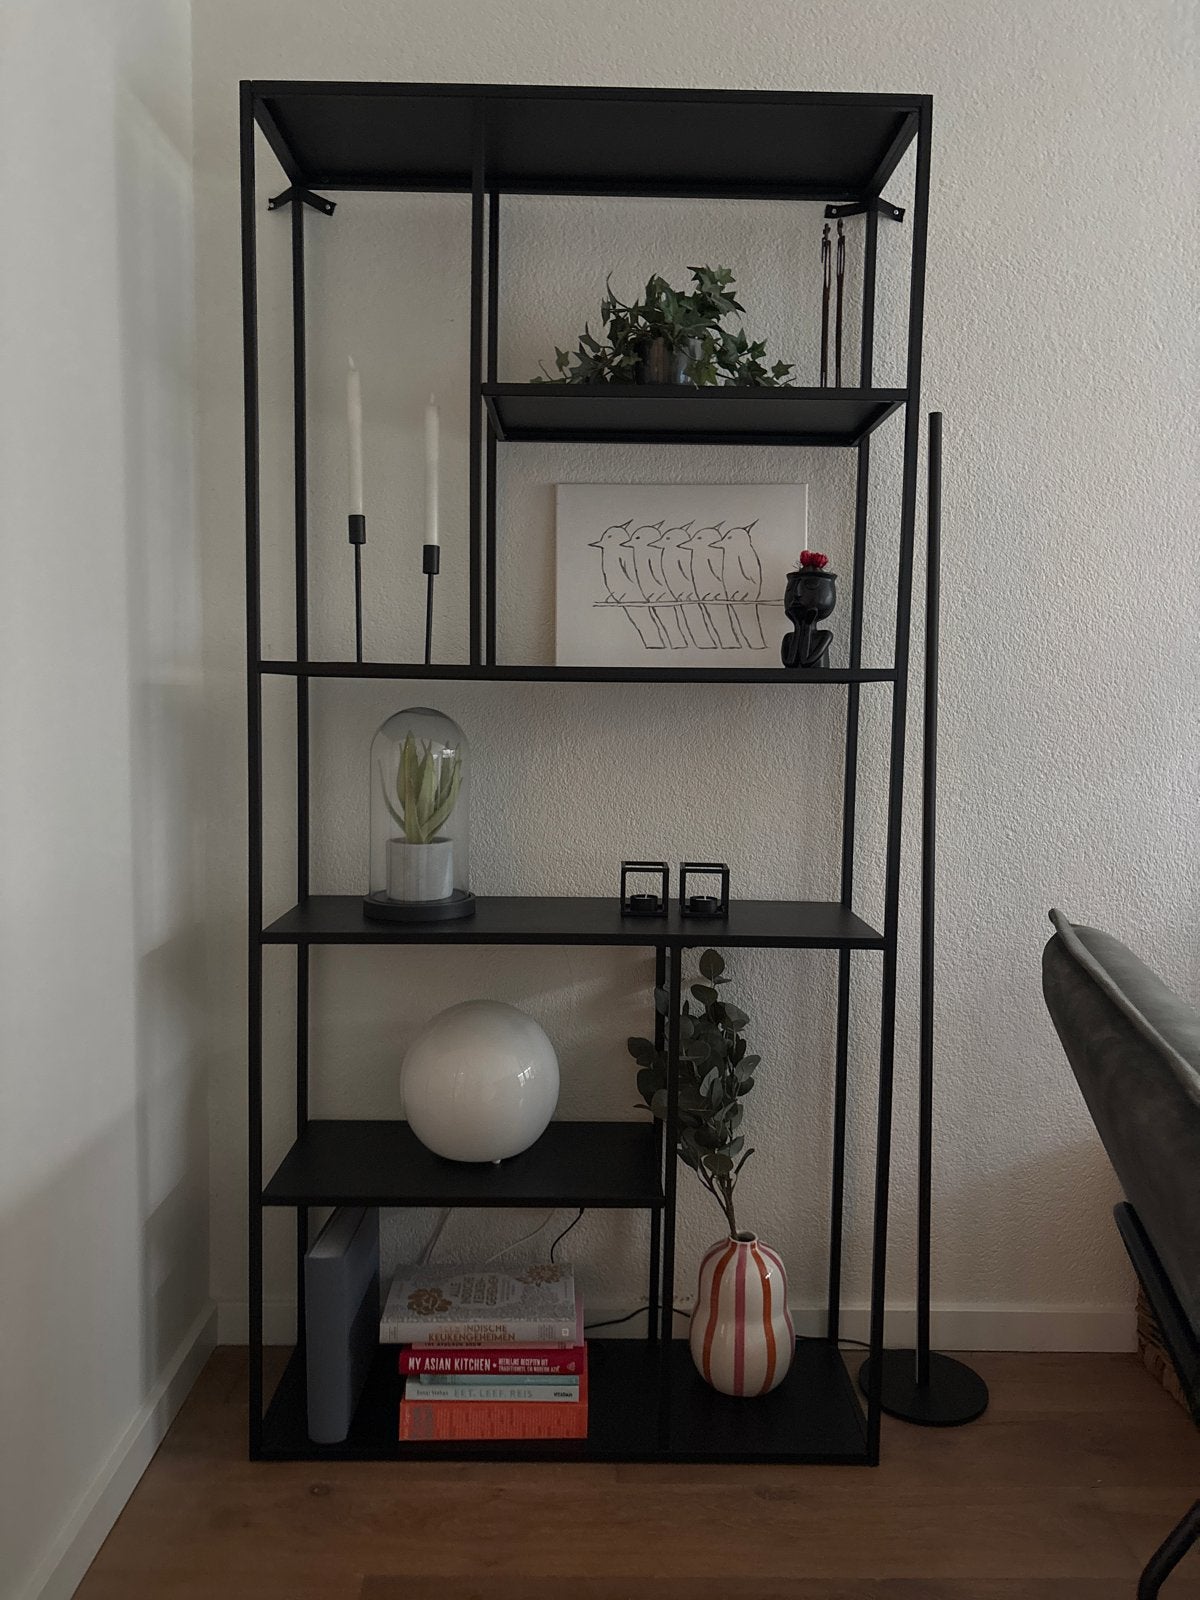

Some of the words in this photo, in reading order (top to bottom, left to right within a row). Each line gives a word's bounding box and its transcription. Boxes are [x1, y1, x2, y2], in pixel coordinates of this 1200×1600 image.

[428, 1333, 516, 1342] KEUKENGEHEIMEN
[408, 1357, 421, 1371] MY
[424, 1357, 451, 1371] ASIAN
[454, 1358, 491, 1371] KITCHEN
[509, 1389, 533, 1398] REIS
